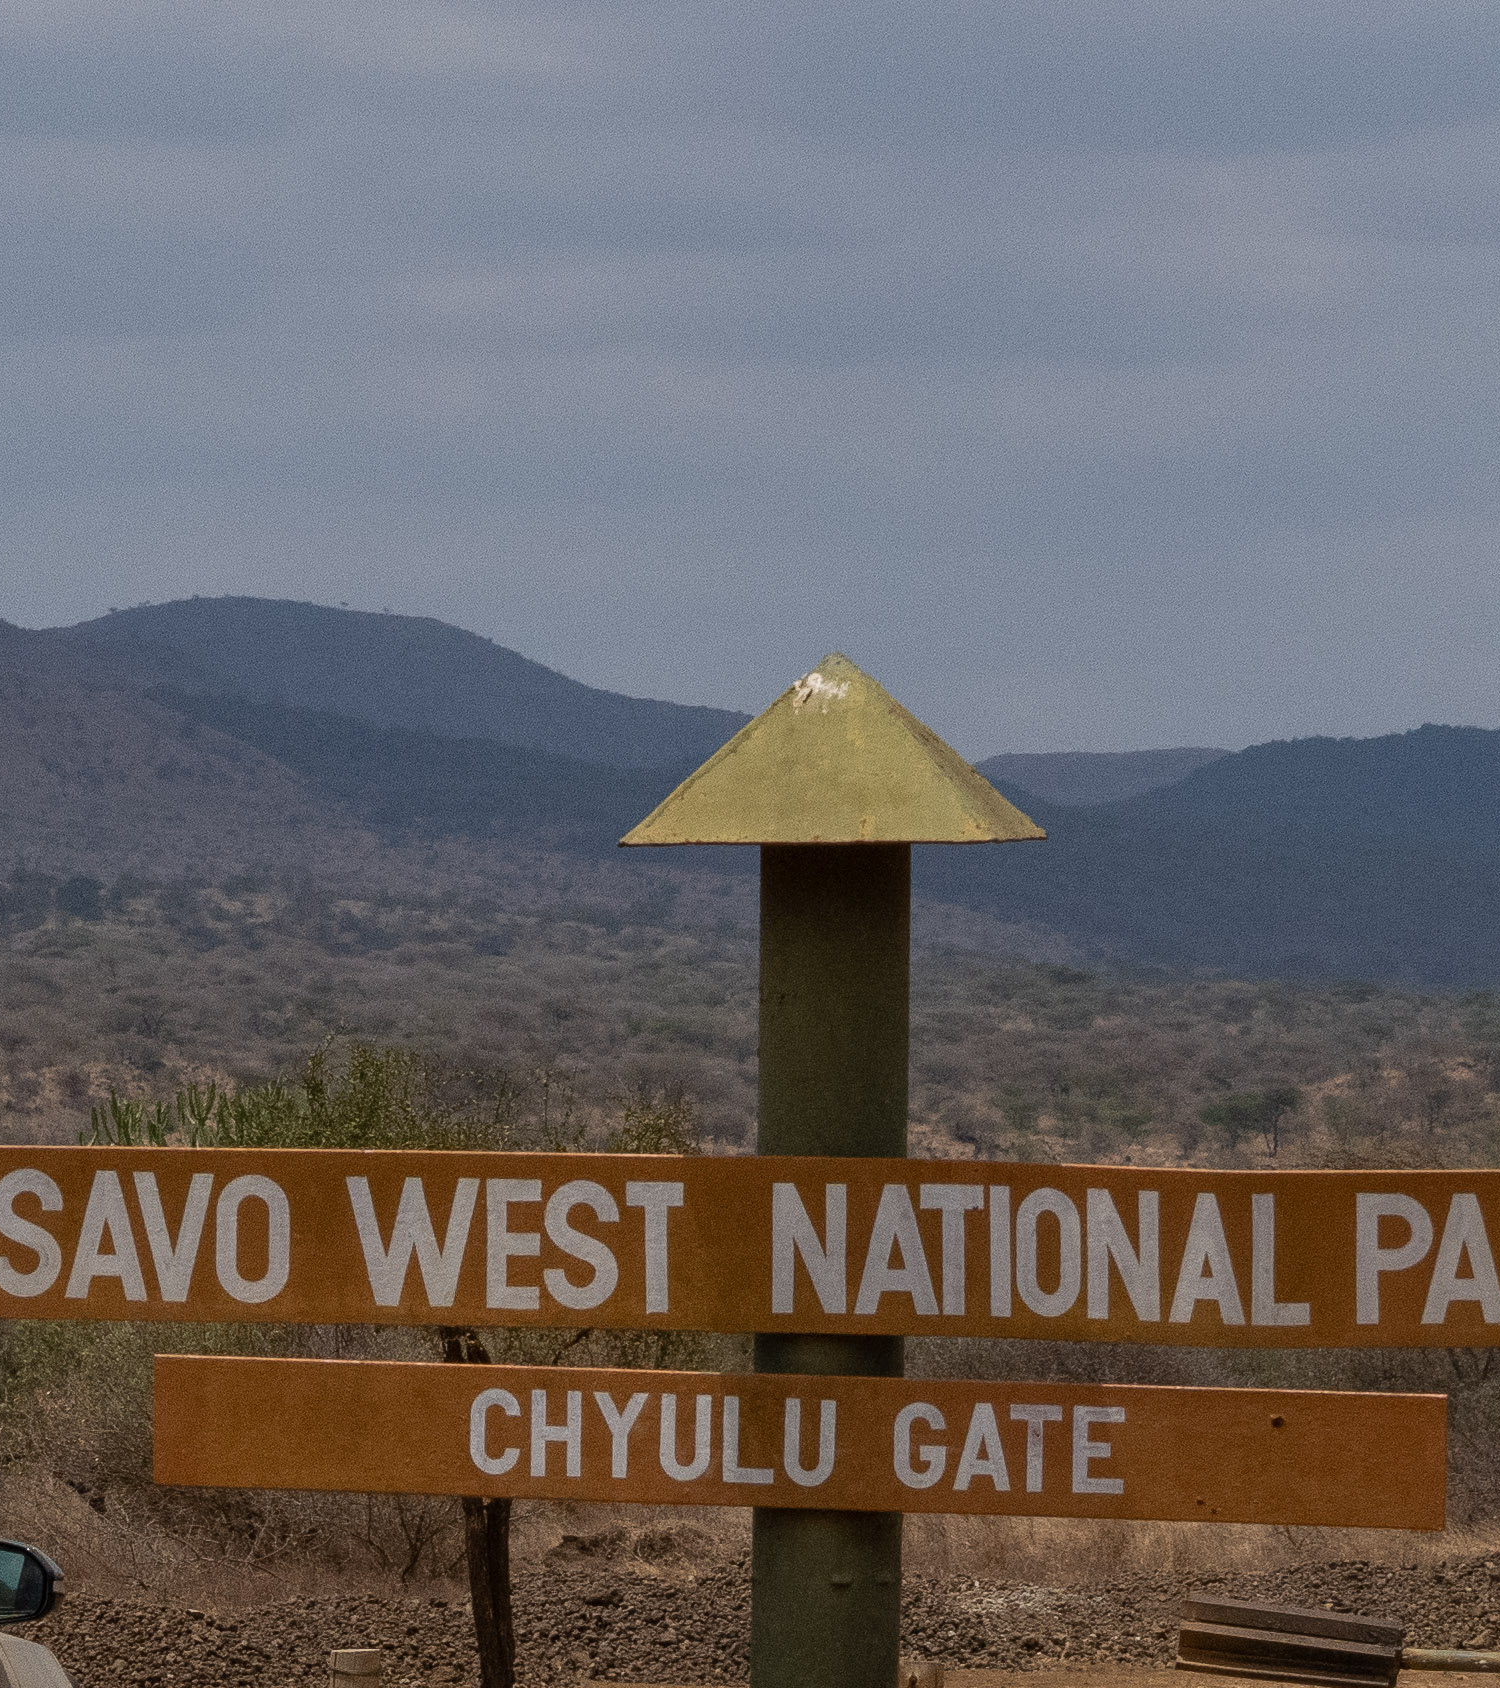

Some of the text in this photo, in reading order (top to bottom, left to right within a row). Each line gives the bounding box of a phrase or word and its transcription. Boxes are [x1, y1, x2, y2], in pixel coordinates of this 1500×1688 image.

[347, 1177, 685, 1314] WEST
[773, 1183, 1311, 1326] NATIONAL
[469, 1388, 1127, 1495] CHYULU GATE
